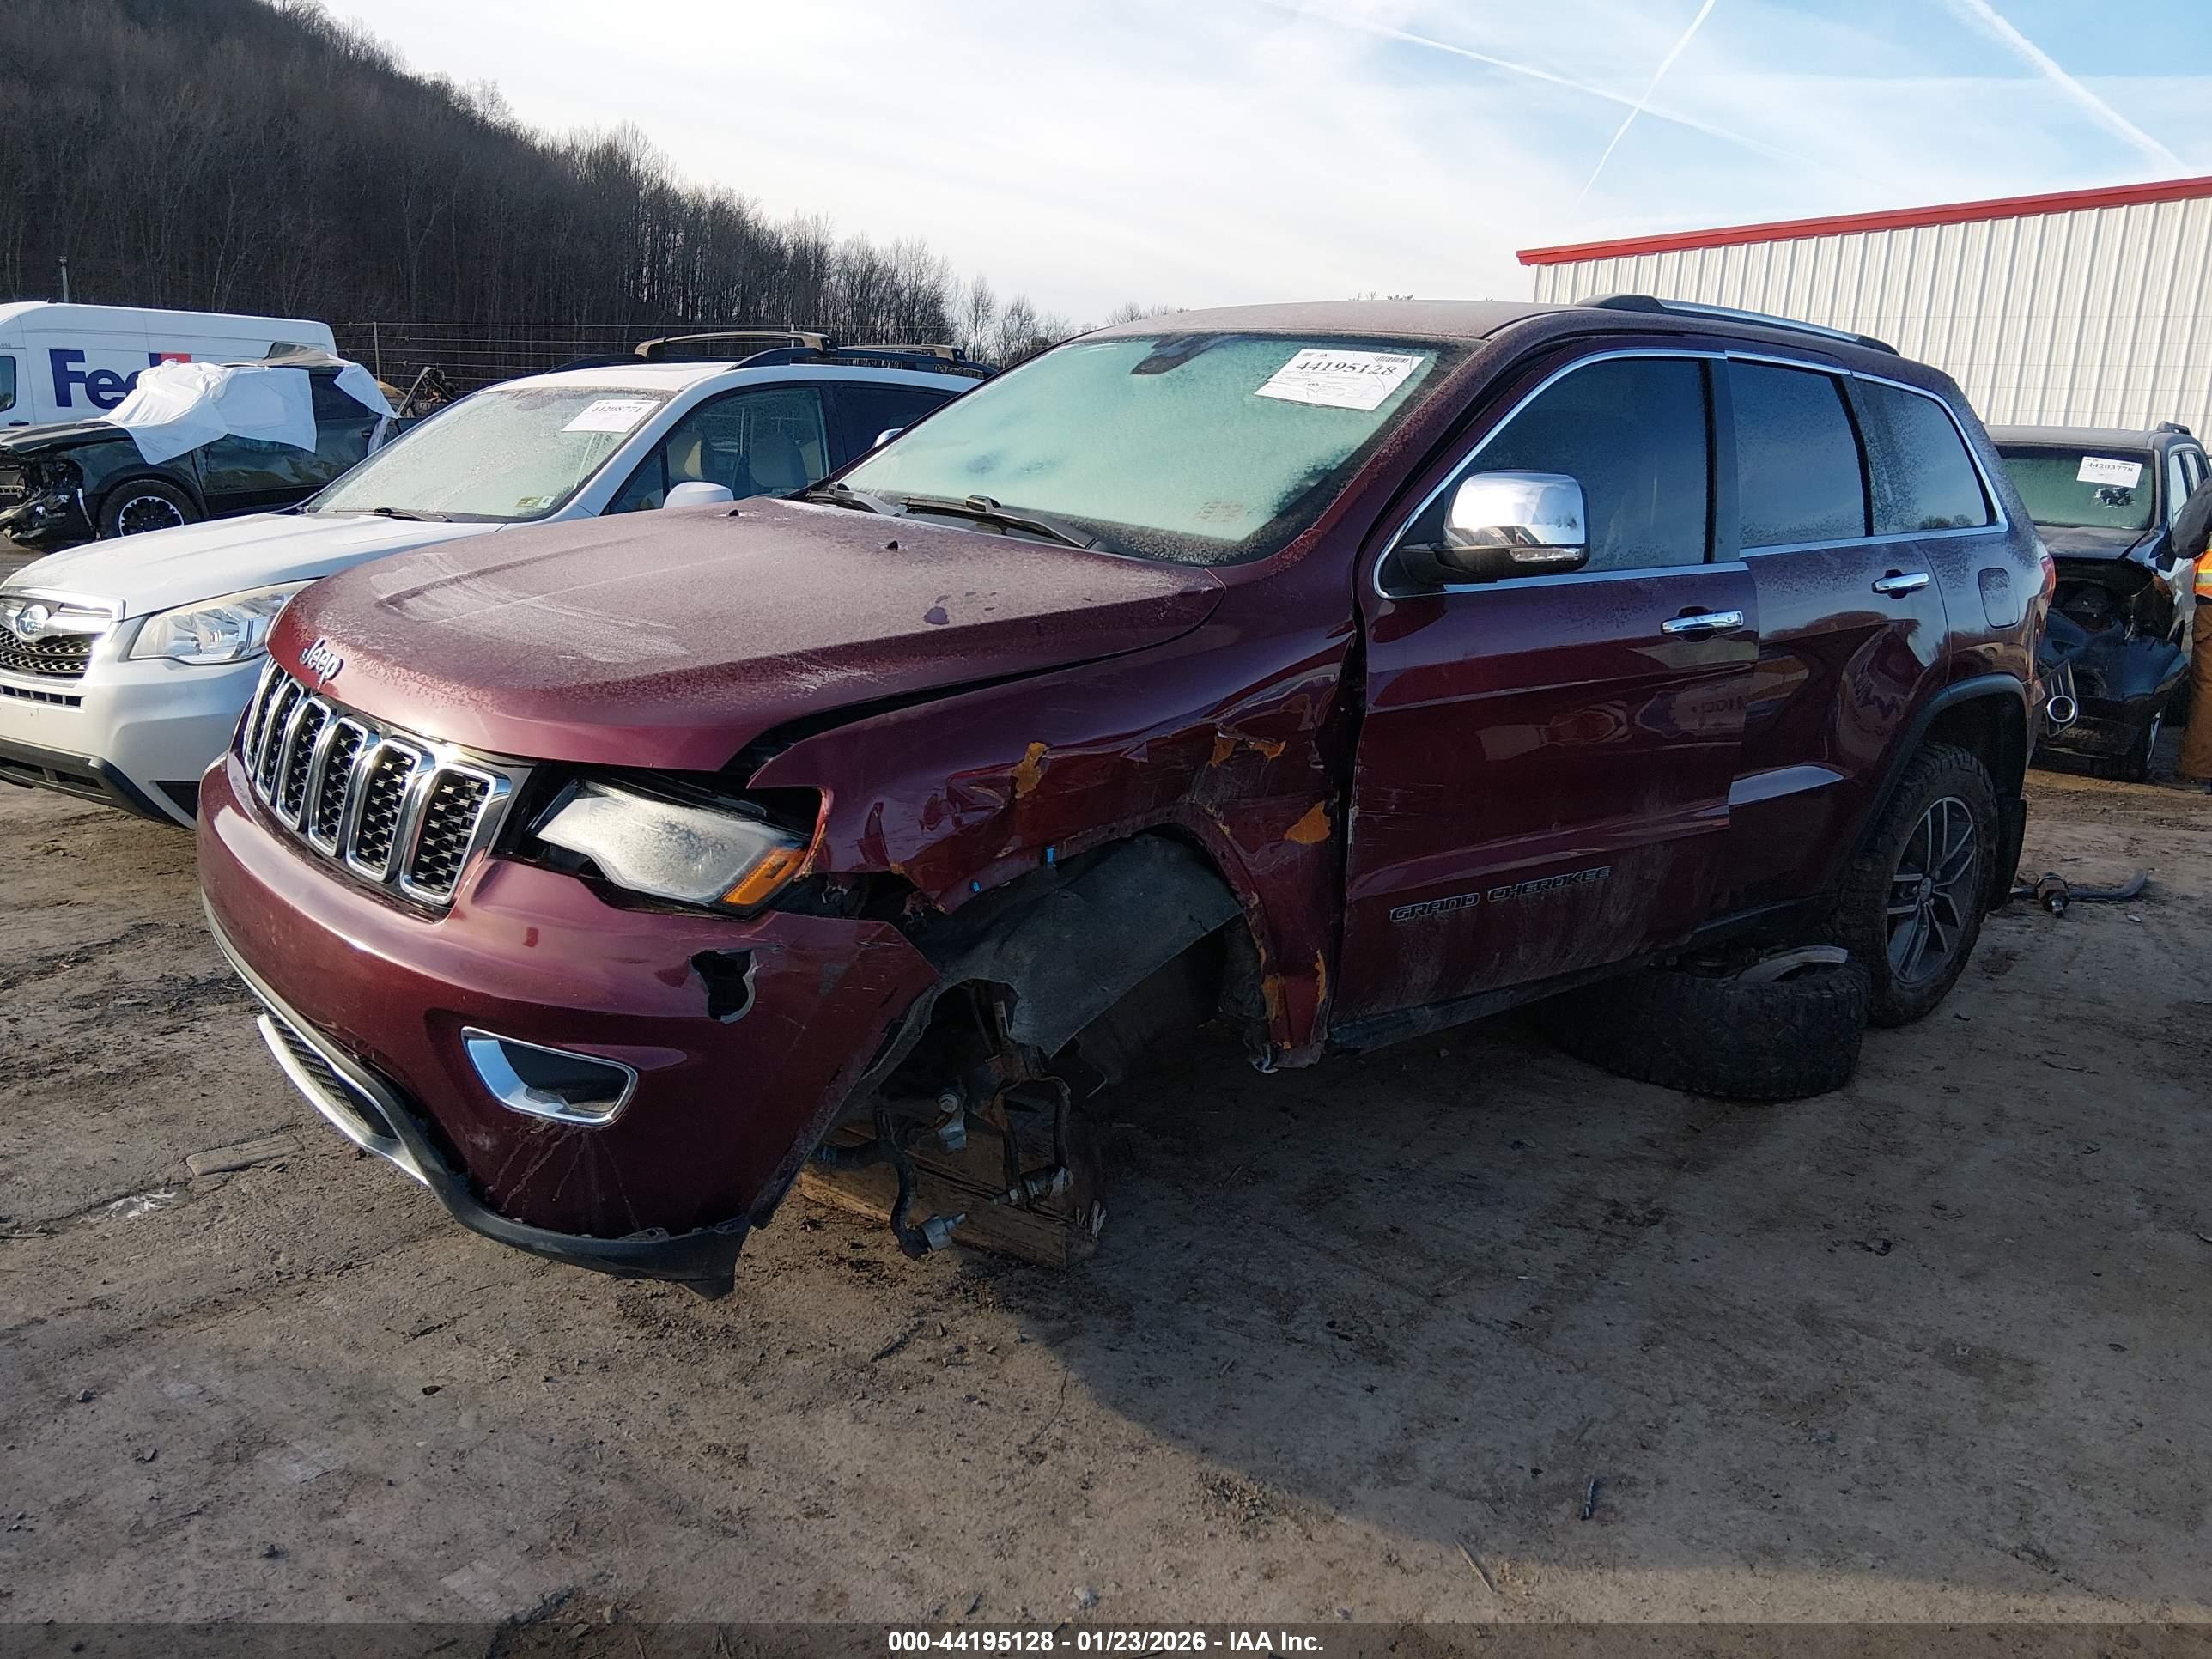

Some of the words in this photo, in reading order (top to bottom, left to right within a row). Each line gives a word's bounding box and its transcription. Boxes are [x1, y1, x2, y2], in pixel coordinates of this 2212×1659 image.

[1296, 361, 1398, 376] 44195128
[299, 637, 343, 690] Jeep
[1389, 893, 1480, 921] GRAND
[1488, 866, 1612, 902] CHEROKEE
